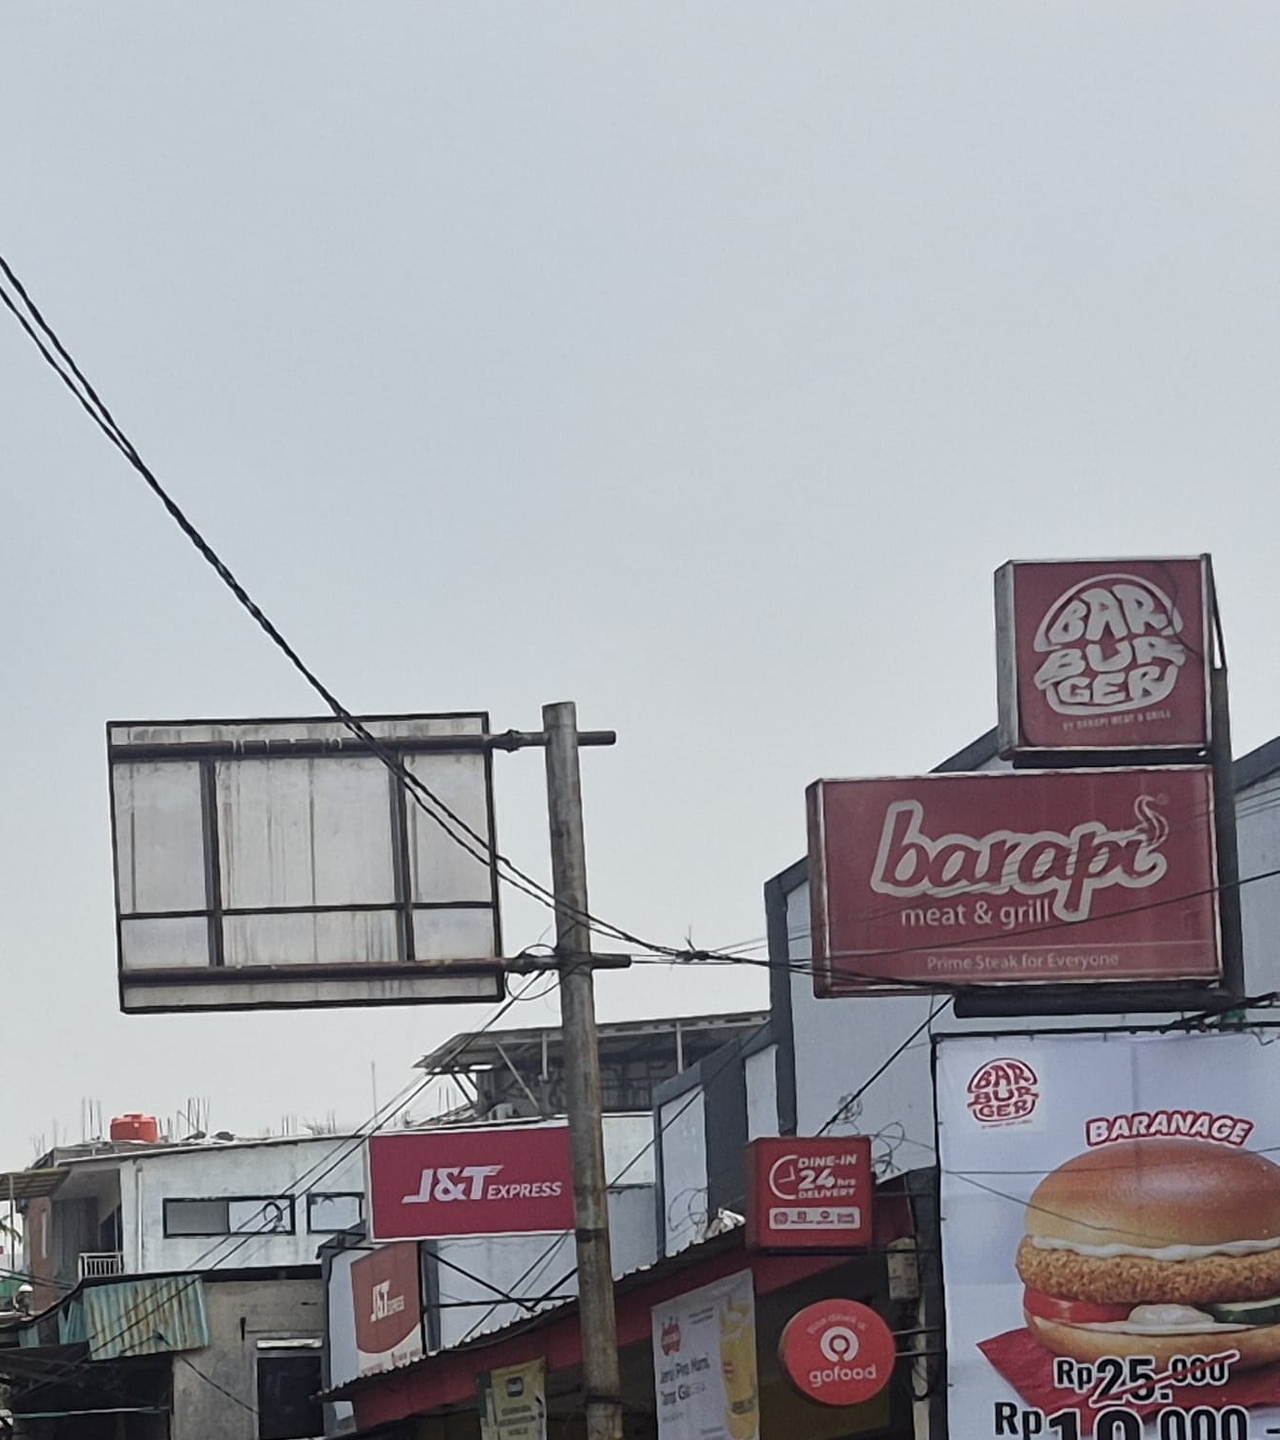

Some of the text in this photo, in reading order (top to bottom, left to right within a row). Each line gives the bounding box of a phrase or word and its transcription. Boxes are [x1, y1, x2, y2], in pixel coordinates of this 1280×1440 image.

[1048, 584, 1169, 644] BAR
[1034, 636, 1186, 690] BUR
[1057, 666, 1166, 704] GER
[870, 800, 1168, 922] barapi
[901, 899, 1050, 930] meat & grill
[927, 952, 1119, 970] Prime Steak for Everyone
[974, 1062, 1032, 1090] BAR
[1085, 1111, 1255, 1147] BARANAGE
[798, 1154, 858, 1168] DINE-IN
[401, 1165, 563, 1204] J&T EXPRESS
[798, 1168, 835, 1190] 24
[798, 1187, 856, 1199] DELIVERY
[809, 1364, 877, 1388] gofood
